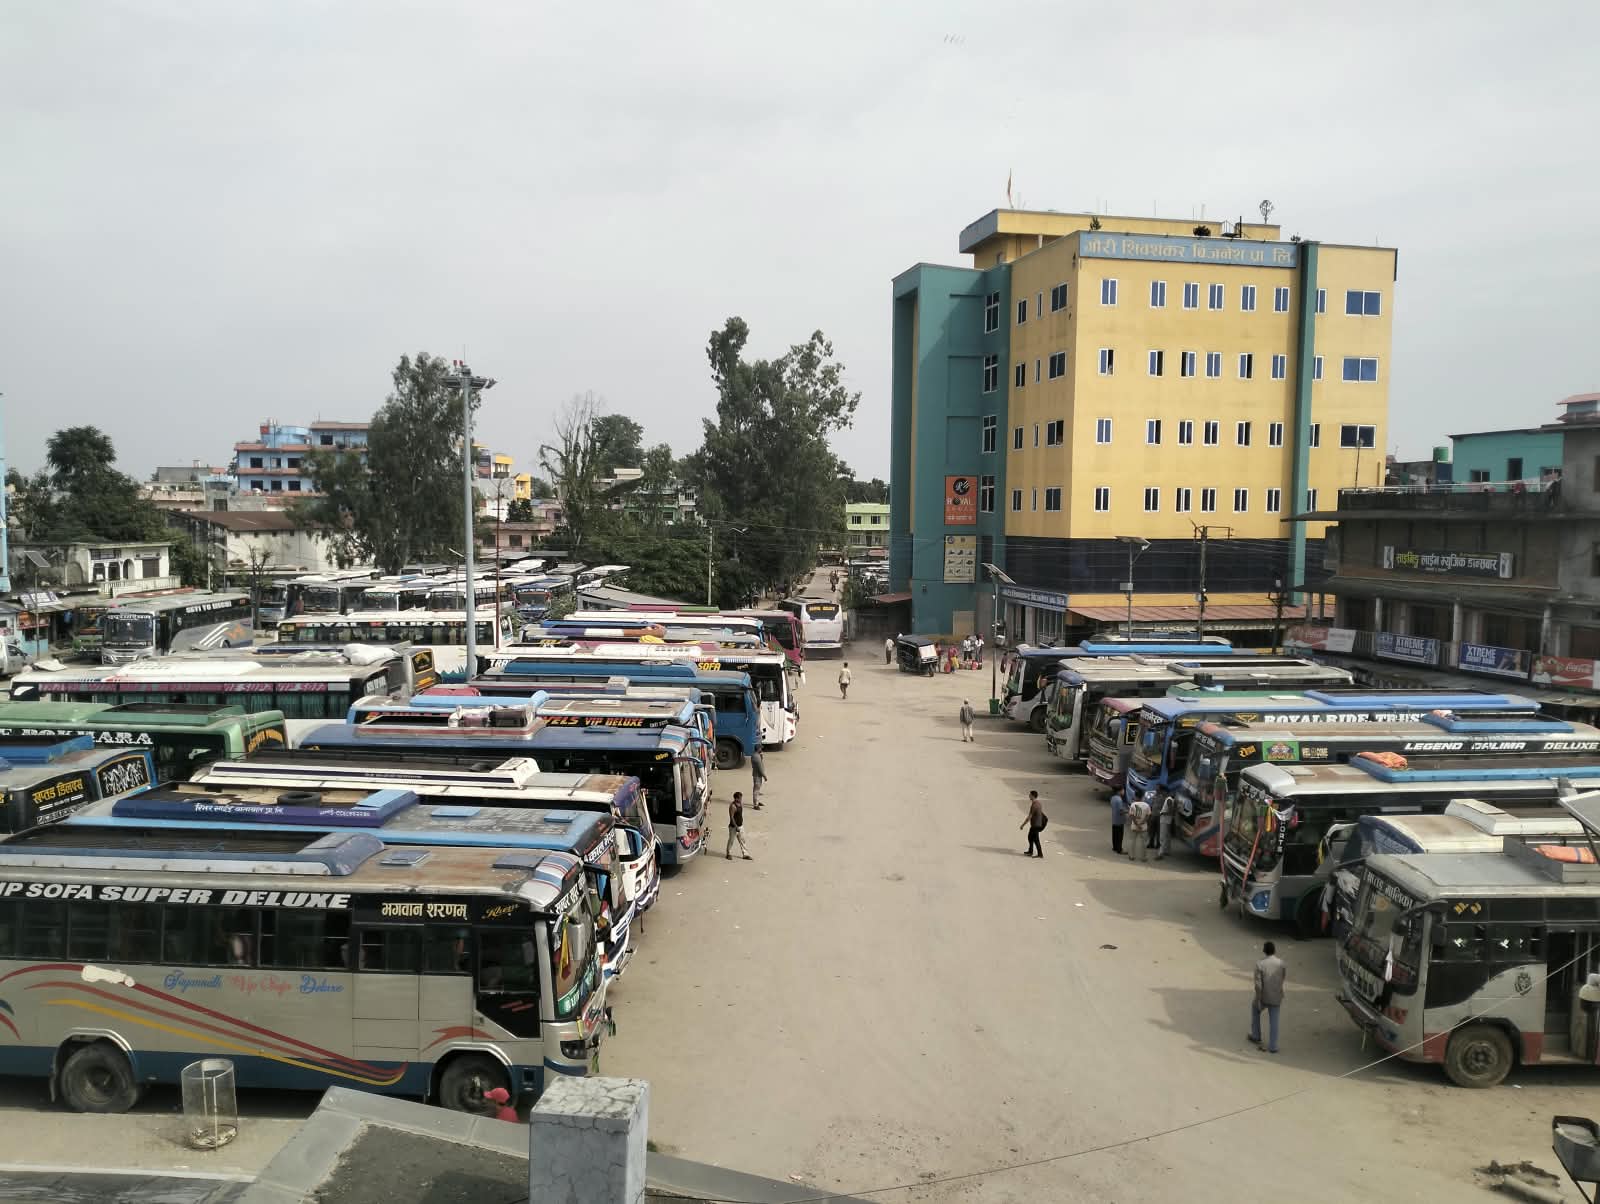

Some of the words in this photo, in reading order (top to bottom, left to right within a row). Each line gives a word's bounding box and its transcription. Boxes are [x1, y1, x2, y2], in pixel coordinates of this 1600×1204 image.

[1467, 645, 1496, 658] XTREME
[698, 662, 721, 671] SOFA
[585, 717, 601, 726] VIP
[605, 717, 645, 727] DELUXE
[1375, 713, 1427, 723] TRUS
[1405, 742, 1463, 750] LEGEND
[1543, 741, 1599, 750] DELUXE
[0, 881, 24, 897] IP
[26, 883, 93, 900] SOFA
[100, 886, 213, 904] SUPER
[221, 890, 352, 909] DELUXE
[382, 902, 424, 917] भगवान
[427, 904, 468, 921] शरणम्
